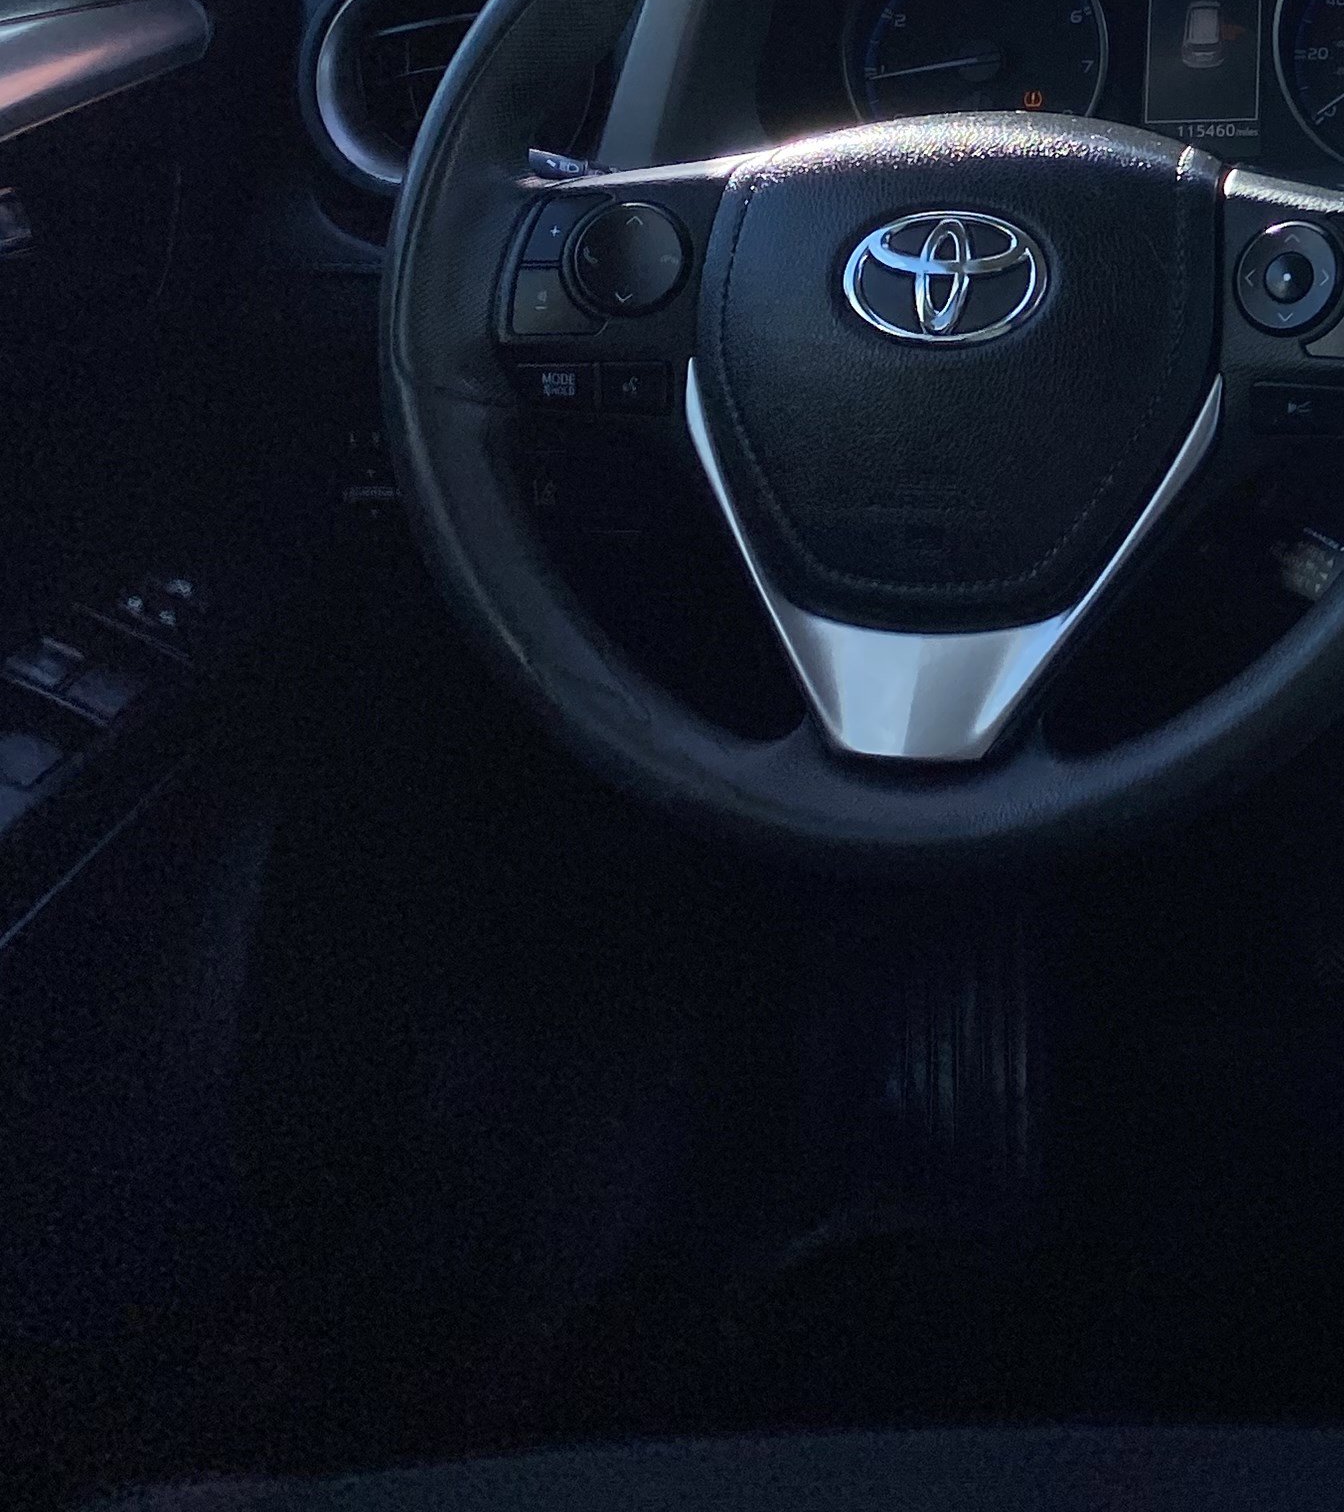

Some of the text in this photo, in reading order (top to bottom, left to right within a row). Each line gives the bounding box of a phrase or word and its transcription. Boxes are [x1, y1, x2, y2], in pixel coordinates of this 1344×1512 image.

[895, 13, 907, 28] 2
[1069, 9, 1083, 24] 6
[1306, 46, 1329, 61] 20
[1080, 59, 1095, 74] 7
[1177, 123, 1236, 138] 115460
[541, 372, 576, 386] MODE
